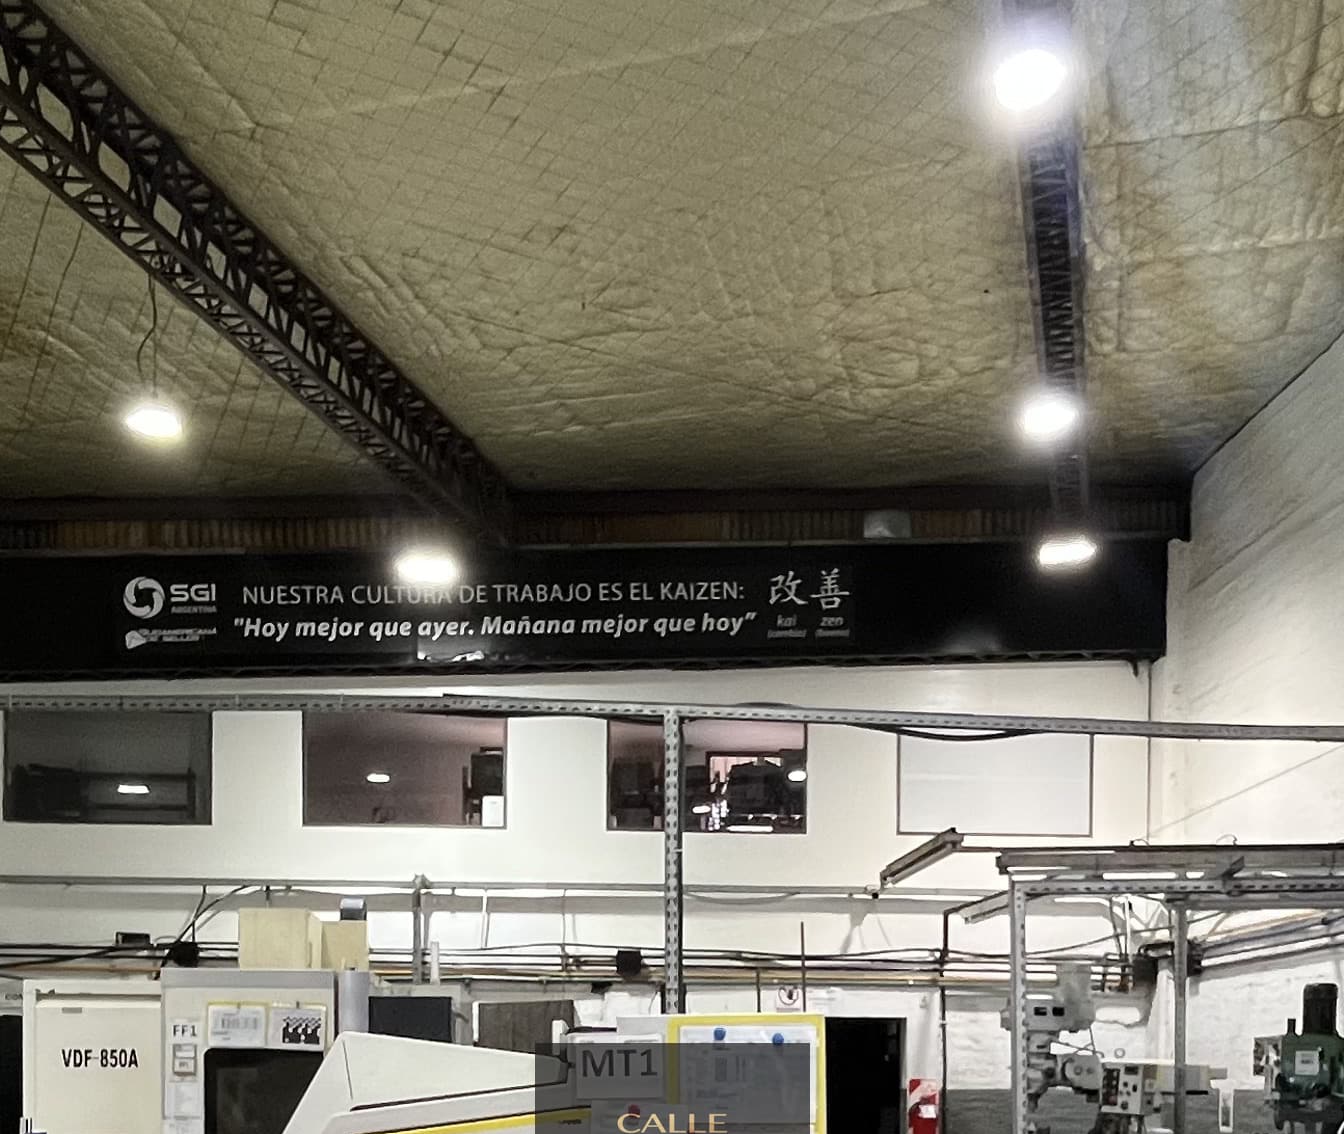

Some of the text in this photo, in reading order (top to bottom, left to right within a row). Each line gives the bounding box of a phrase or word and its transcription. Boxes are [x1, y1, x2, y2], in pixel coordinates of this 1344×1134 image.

[169, 583, 217, 602] SGI
[242, 580, 745, 605] NUESTRA CULTURA DE TRABAJO ES EL KAIZEN:
[768, 567, 851, 611] 改善
[295, 617, 364, 642] mejor
[369, 619, 412, 641] que
[418, 619, 475, 641] ayer.
[481, 615, 575, 636] Mañana
[581, 613, 648, 638] mejor
[653, 616, 696, 637] que
[777, 614, 797, 627] kai
[820, 616, 844, 627] zen
[173, 1024, 197, 1037] FF1
[61, 1049, 139, 1069] VDF-850A
[582, 1048, 658, 1077] MT1
